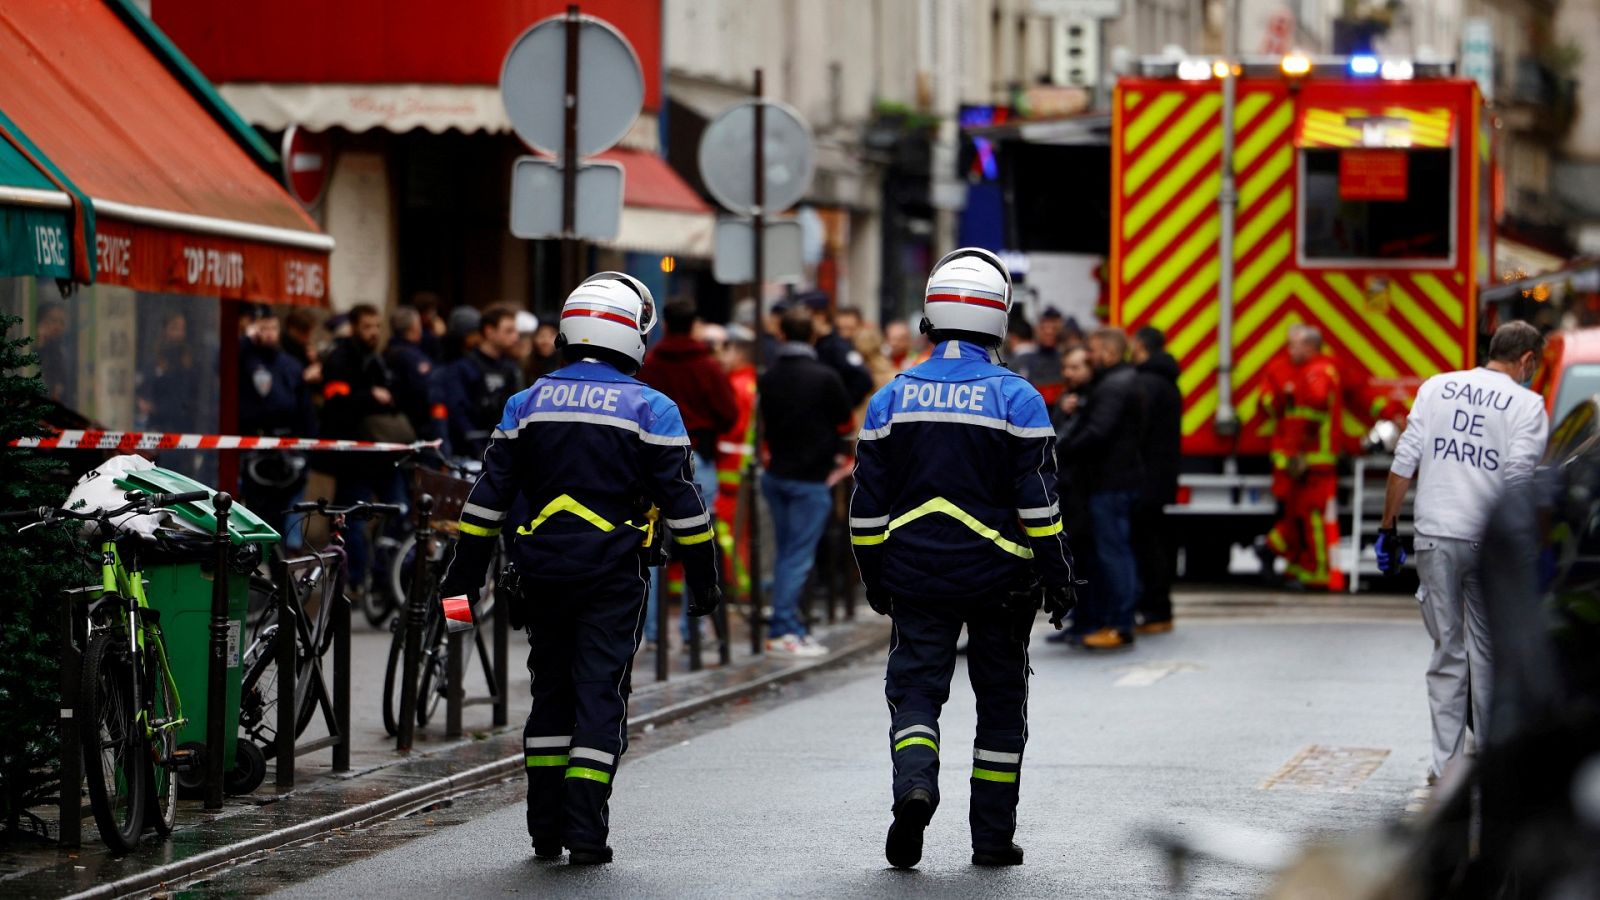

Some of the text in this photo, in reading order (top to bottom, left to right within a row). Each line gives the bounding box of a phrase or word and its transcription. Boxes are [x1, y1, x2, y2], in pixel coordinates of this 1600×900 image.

[32, 225, 66, 266] IBRE
[96, 233, 132, 276] ERVICE
[536, 384, 621, 412] POLICE
[902, 382, 986, 411] POLICE
[1441, 381, 1513, 411] SAMU
[1452, 409, 1486, 437] DE
[1433, 437, 1500, 471] PARIS
